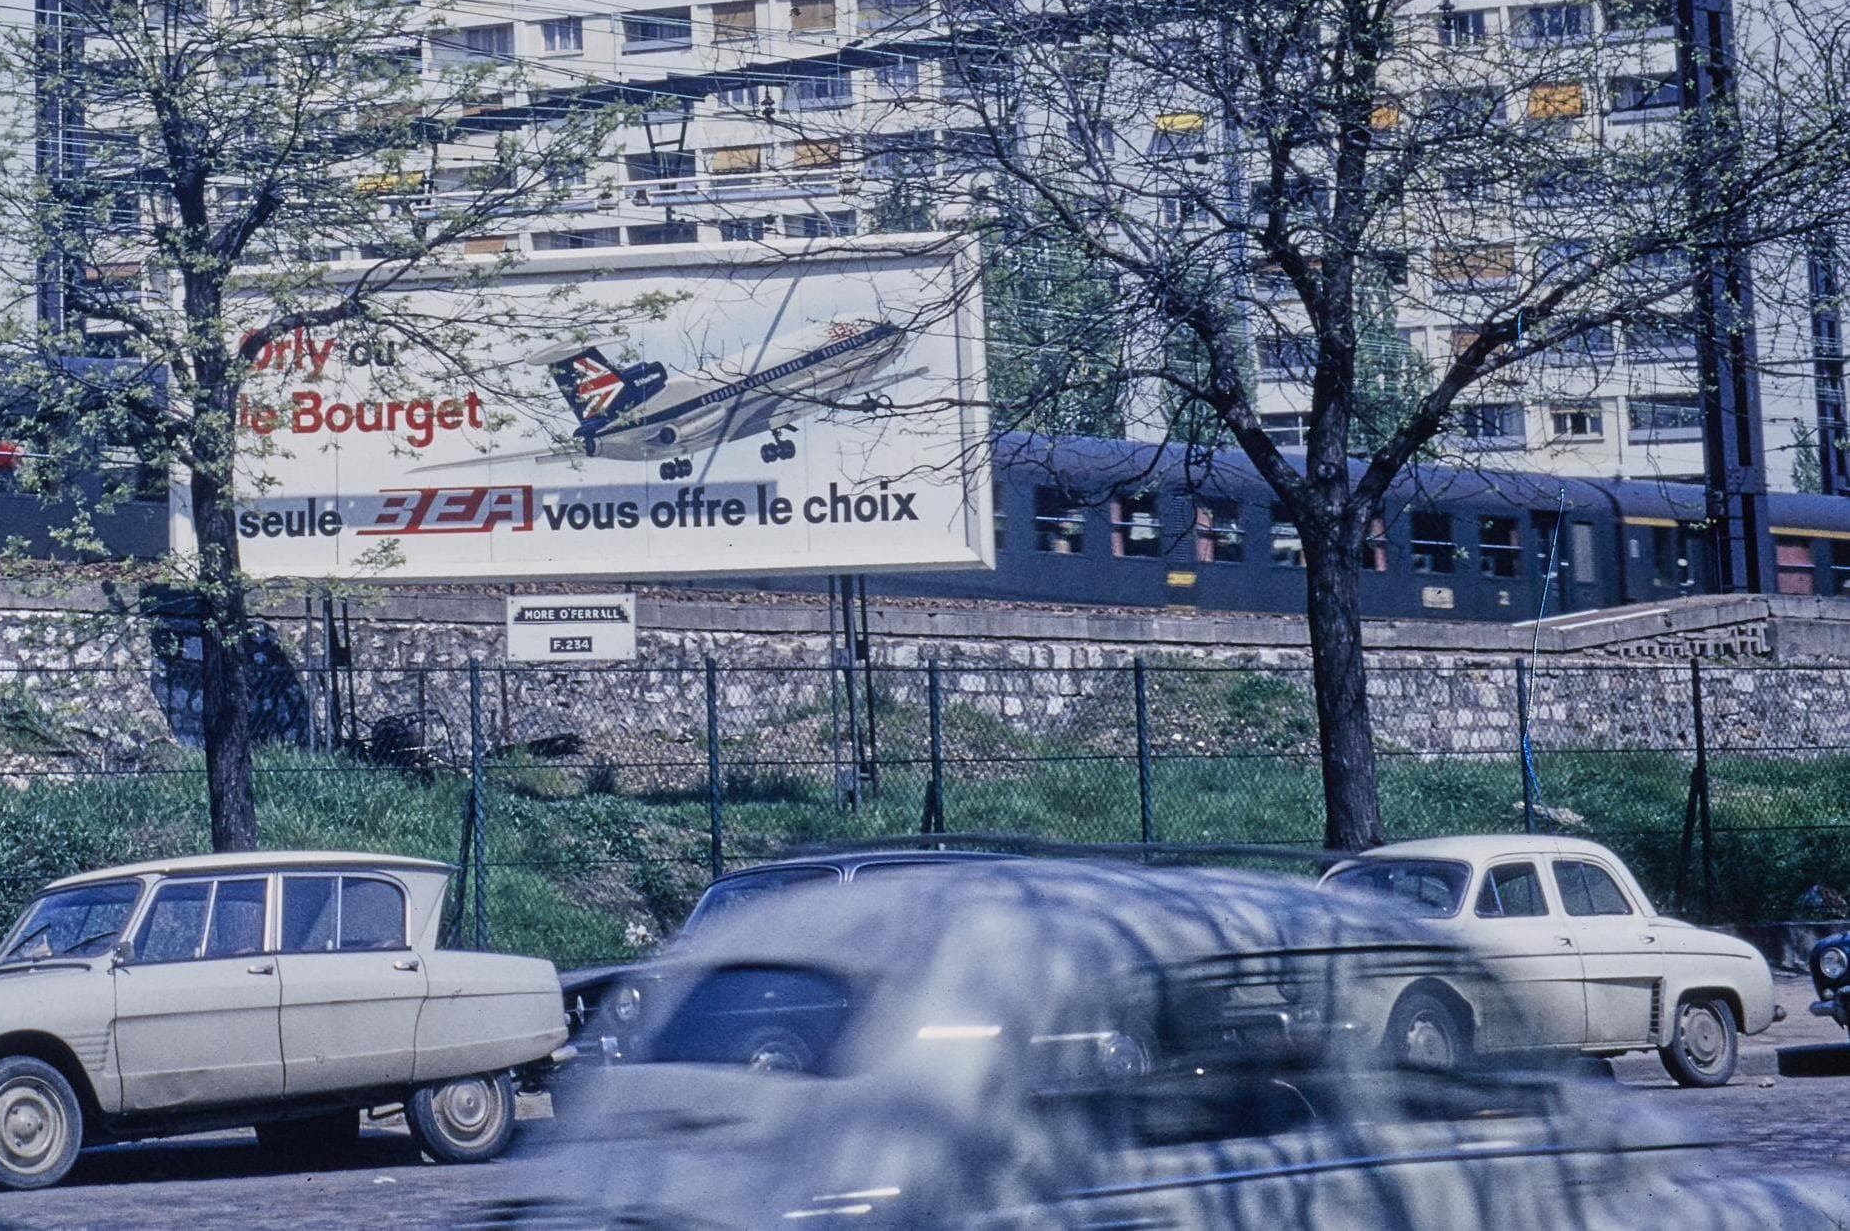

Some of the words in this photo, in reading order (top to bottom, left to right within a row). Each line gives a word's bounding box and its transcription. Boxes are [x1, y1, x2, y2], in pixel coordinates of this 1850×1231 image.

[349, 340, 396, 367] ou
[240, 392, 279, 435] le
[291, 391, 483, 448] Bourget
[239, 497, 343, 538] seule
[358, 485, 533, 535] BEA
[542, 500, 640, 531] vous
[650, 486, 747, 528] offre
[756, 483, 793, 526] le
[803, 480, 920, 524] choix
[524, 609, 555, 620] MORE
[559, 607, 620, 620] O'FERRALL
[552, 638, 590, 650] F.234
